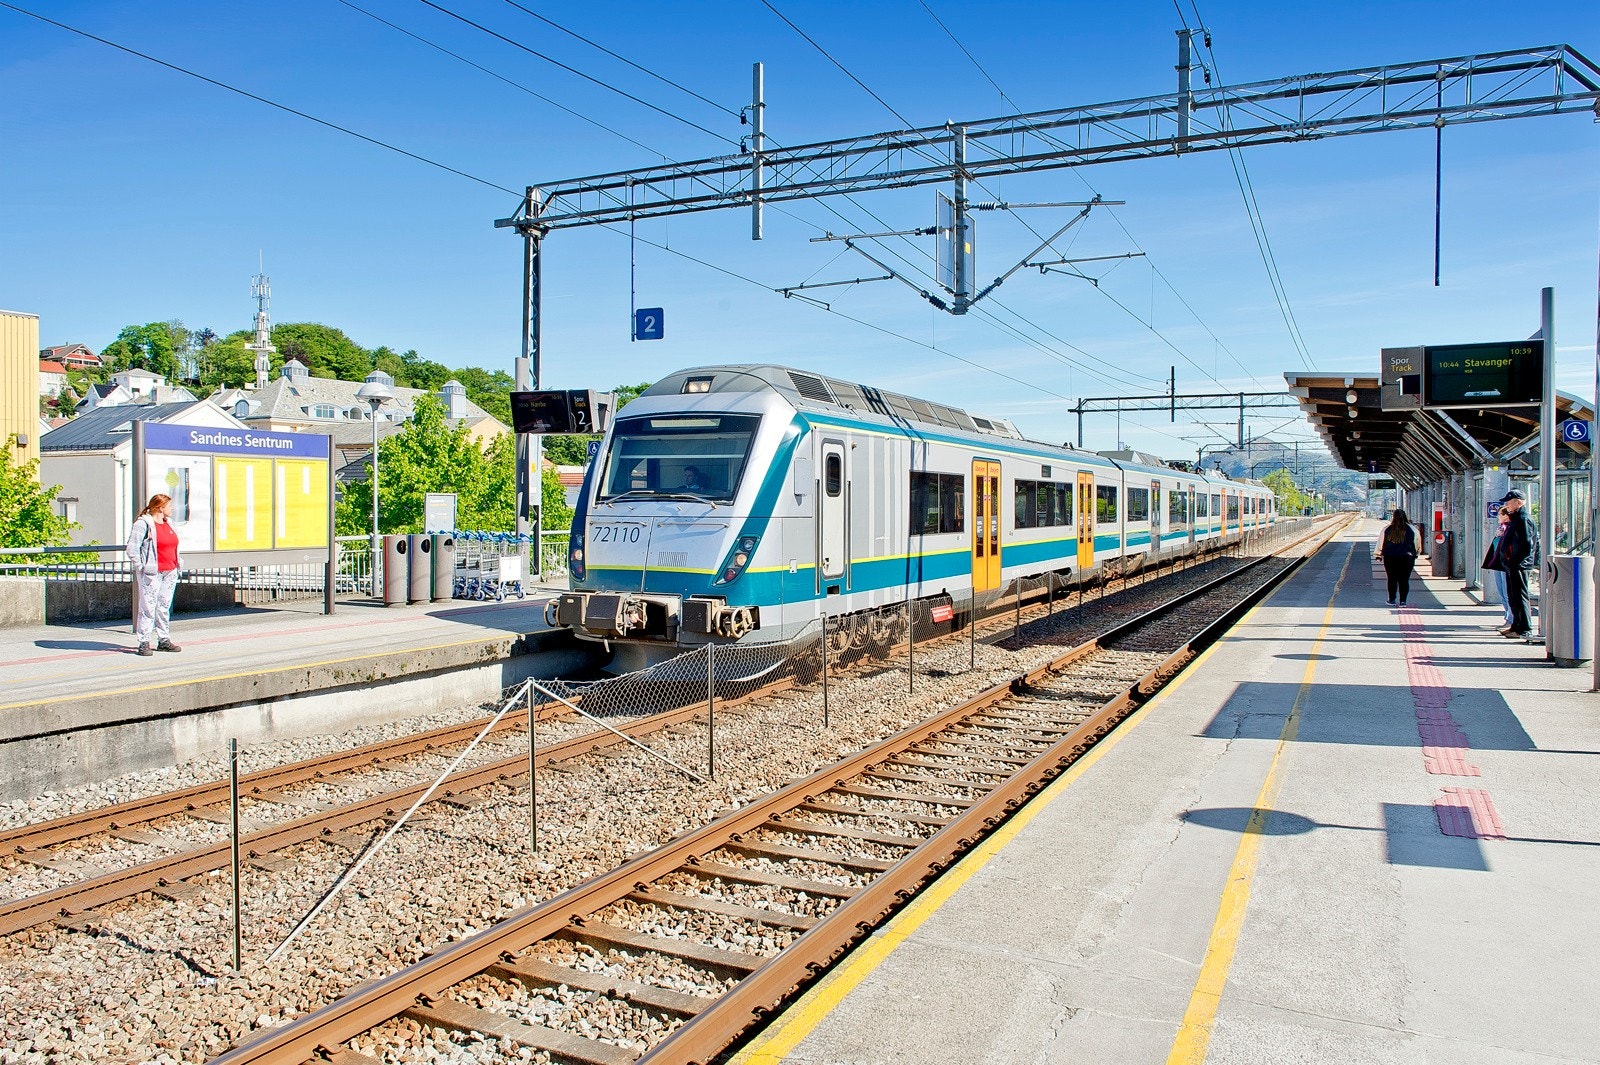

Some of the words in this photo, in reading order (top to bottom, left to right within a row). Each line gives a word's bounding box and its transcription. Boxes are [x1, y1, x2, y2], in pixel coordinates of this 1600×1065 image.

[644, 315, 656, 333] 2
[1510, 347, 1532, 355] 10:39
[1390, 357, 1409, 366] Spor
[1391, 364, 1413, 372] Track
[1439, 361, 1459, 369] 10:44
[1464, 357, 1513, 369] Stavanger
[1395, 377, 1403, 396] 1
[577, 410, 586, 425] 2
[190, 430, 243, 447] Sandnes
[245, 434, 293, 450] Sentrum
[592, 526, 640, 544] 72110
